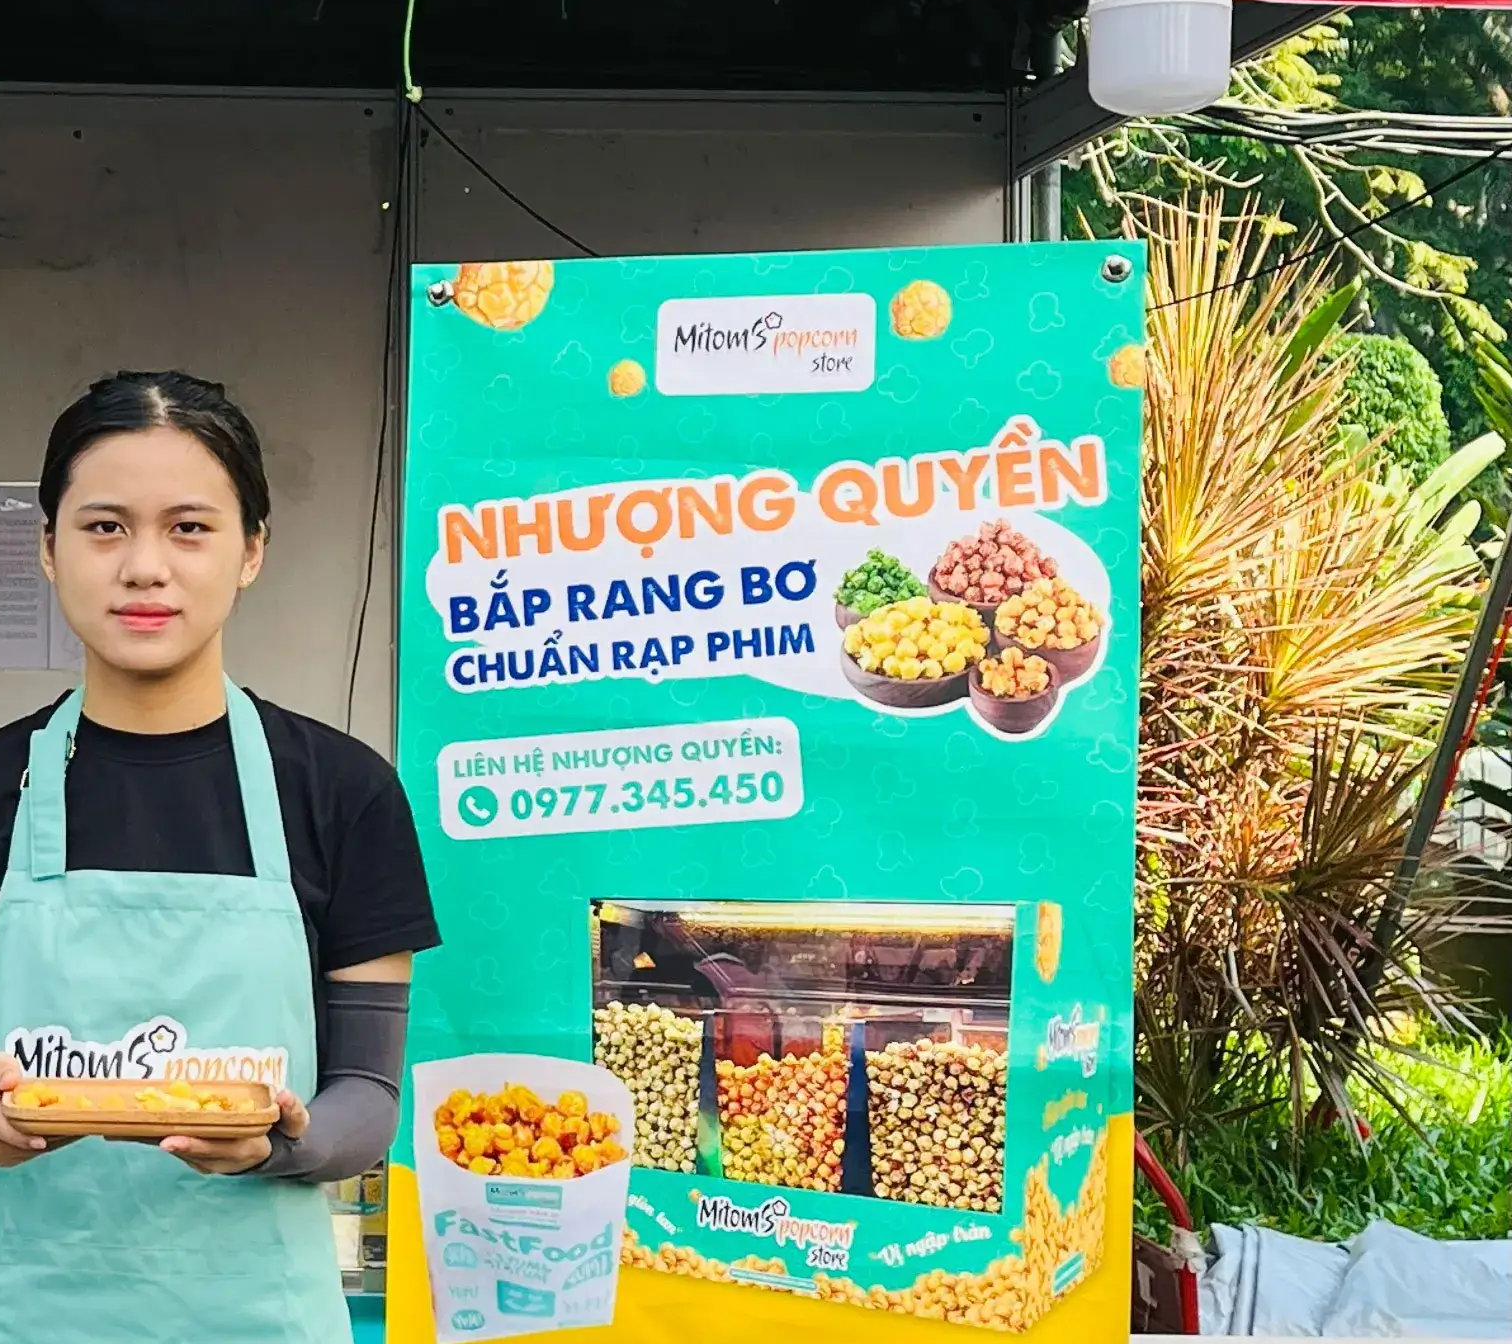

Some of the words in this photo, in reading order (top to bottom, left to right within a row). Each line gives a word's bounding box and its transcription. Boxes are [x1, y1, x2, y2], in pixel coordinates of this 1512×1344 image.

[773, 328, 857, 358] popcorn
[810, 353, 853, 373] store
[445, 476, 797, 563] NHƯỢNG
[820, 424, 1101, 526] QUYỀN
[450, 569, 552, 634] BẮP
[569, 568, 725, 622] RANG
[742, 557, 817, 607] BƠ
[452, 630, 600, 685] CHUẨN
[614, 638, 696, 672] RẠP
[708, 623, 815, 662] PHIM
[454, 751, 506, 778] LIÊN
[514, 747, 544, 777] HỆ
[553, 741, 673, 771] NHƯỢNG
[510, 771, 784, 820] 0977.345.450
[777, 1219, 852, 1245] popcorn
[811, 1247, 846, 1268] store
